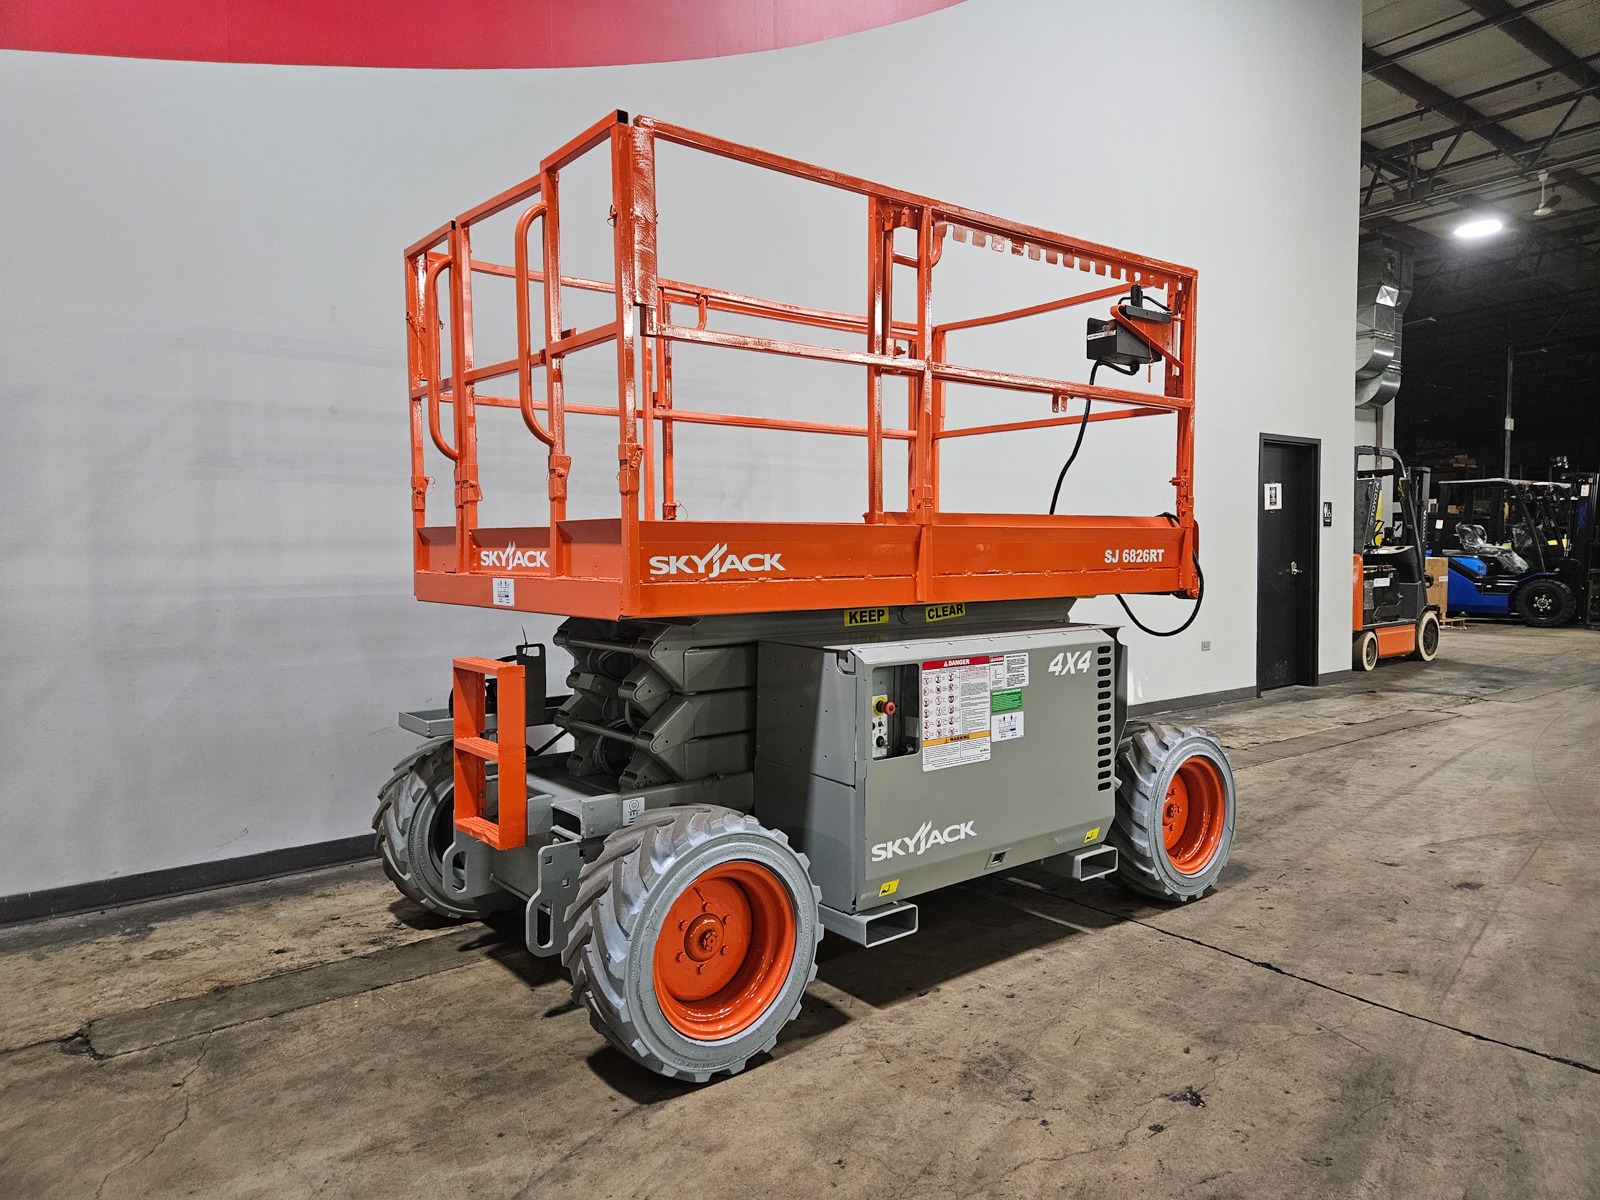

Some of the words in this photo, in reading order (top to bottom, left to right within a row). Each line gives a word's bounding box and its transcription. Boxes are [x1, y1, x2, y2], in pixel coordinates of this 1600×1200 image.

[1370, 480, 1380, 517] TOYOTA
[480, 541, 549, 570] SKYJACK
[648, 543, 786, 578] SKYJACK
[1104, 549, 1119, 563] SJ
[1122, 548, 1164, 563] 6826RT
[848, 609, 885, 624] KEEP
[927, 603, 965, 621] CLEAR
[948, 658, 970, 667] DANGER
[1048, 650, 1092, 676] 4X4
[949, 734, 970, 742] WARNING
[871, 820, 977, 863] SKYJACK
